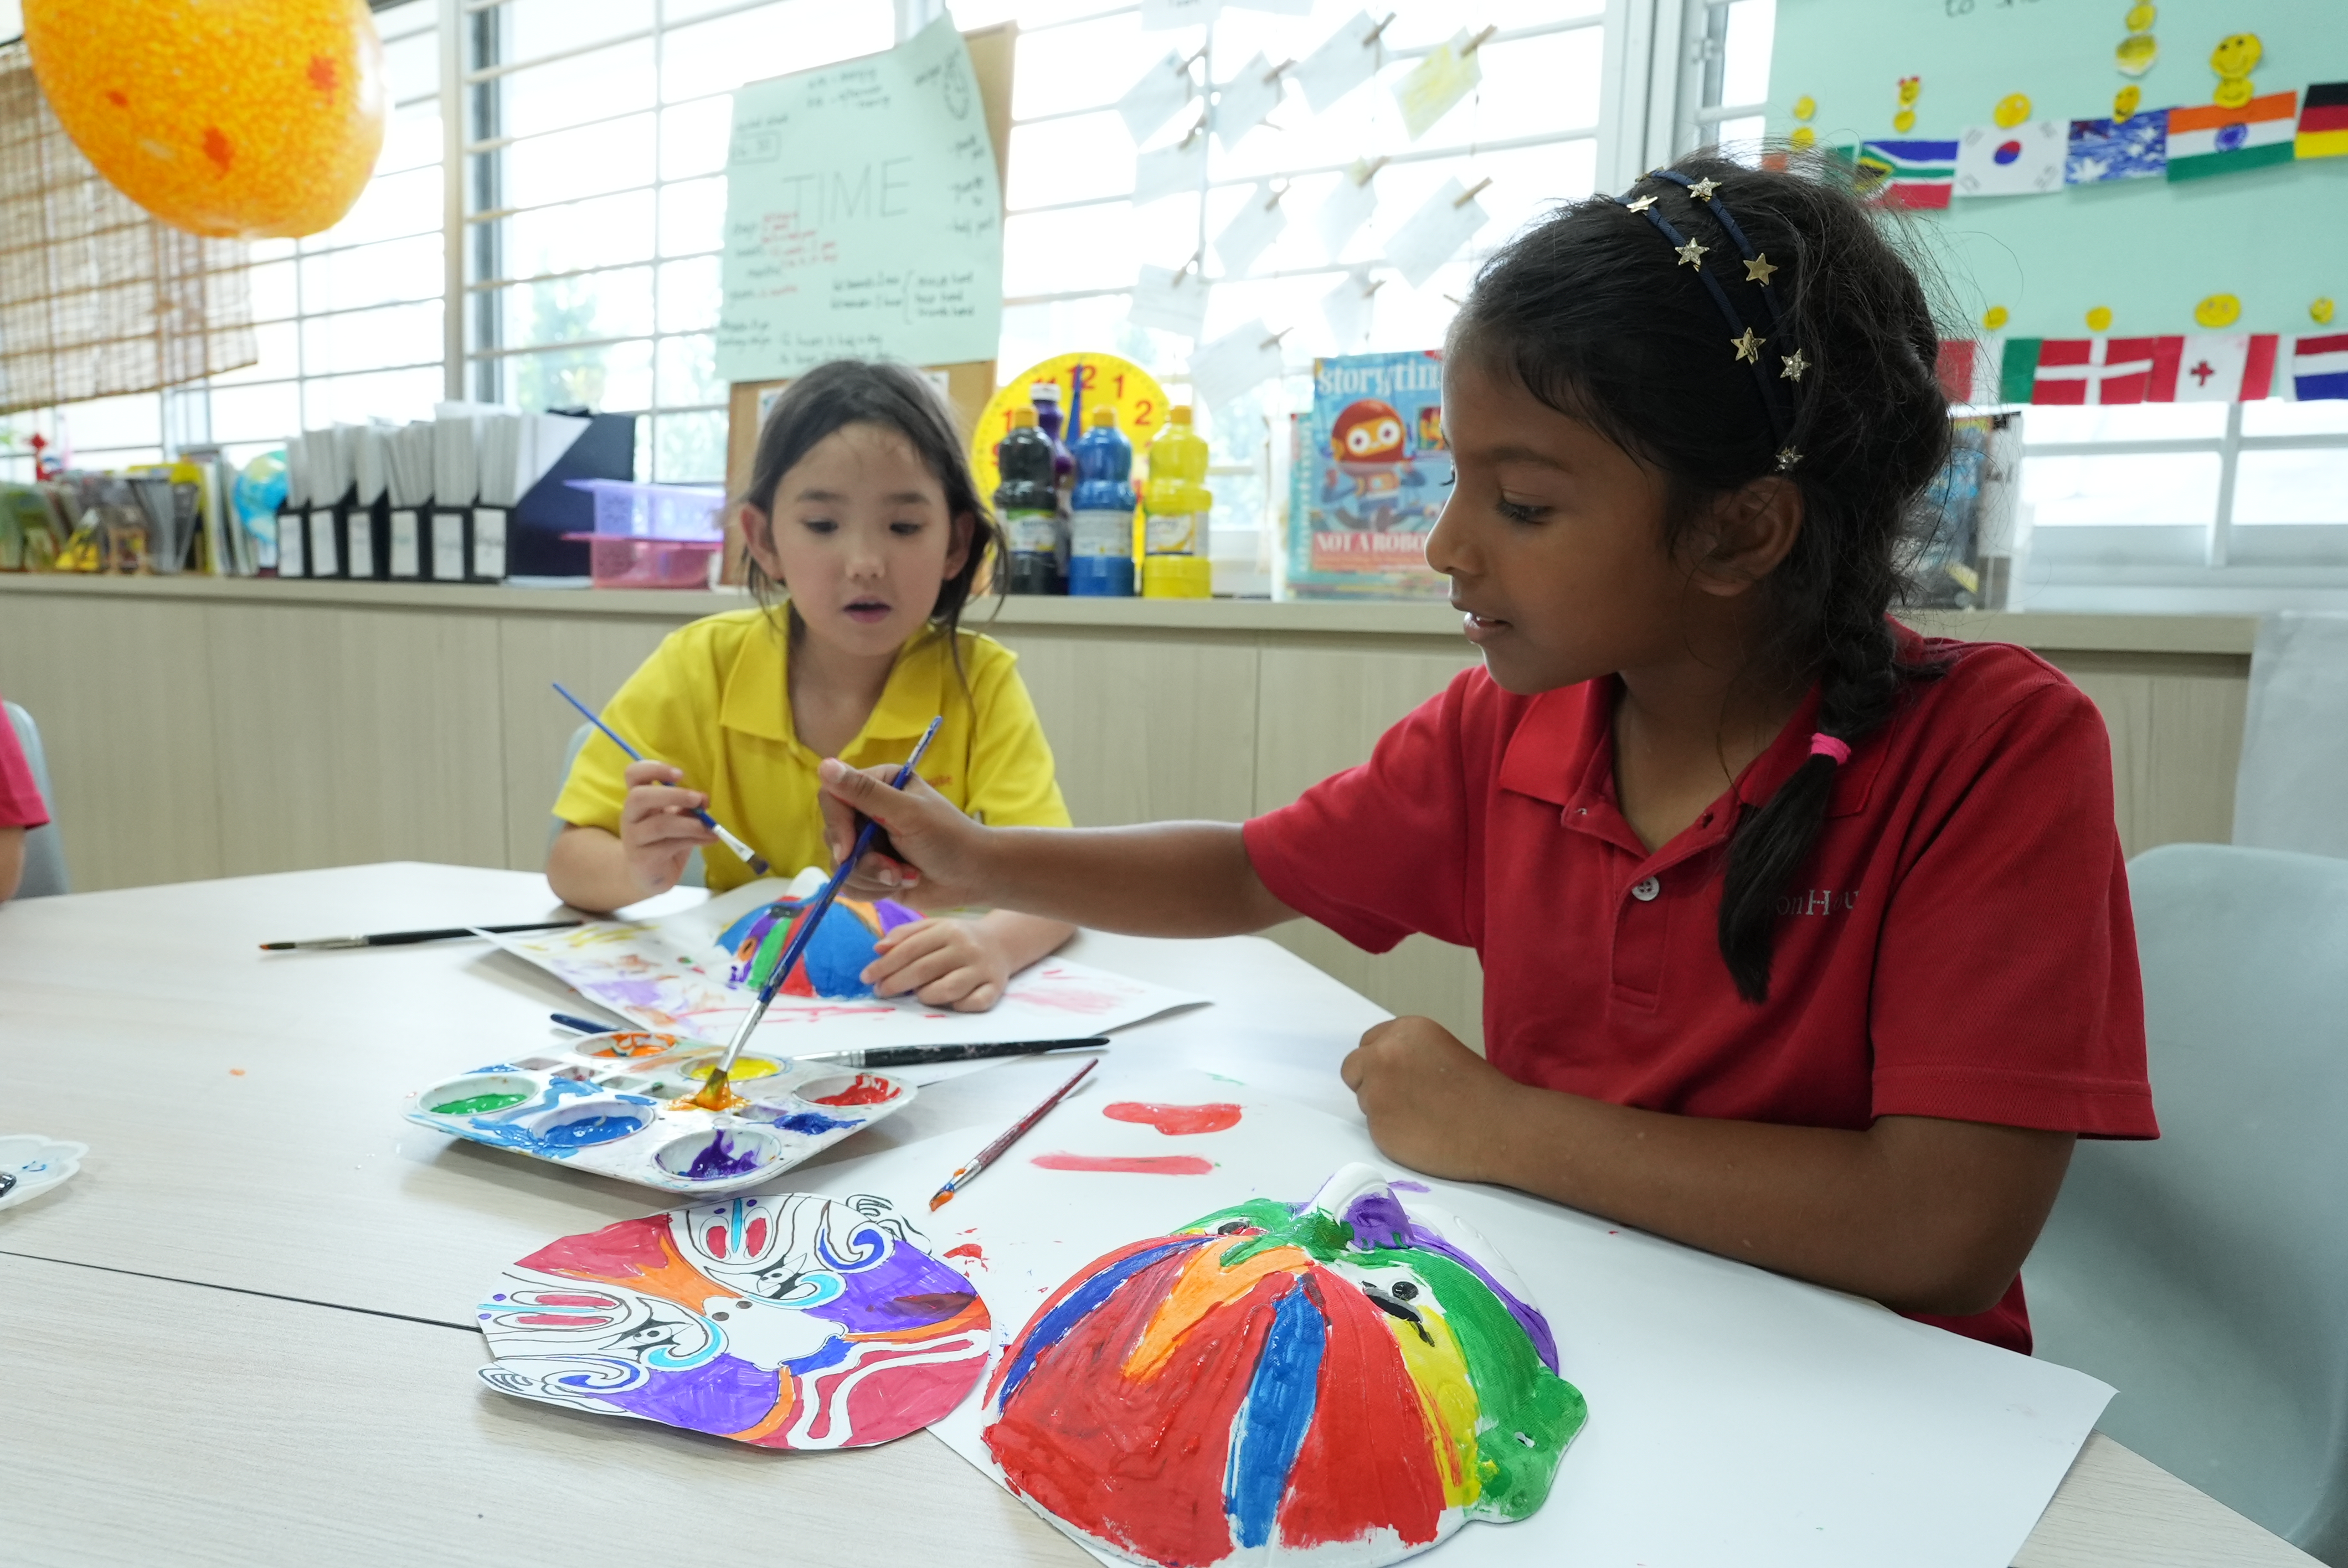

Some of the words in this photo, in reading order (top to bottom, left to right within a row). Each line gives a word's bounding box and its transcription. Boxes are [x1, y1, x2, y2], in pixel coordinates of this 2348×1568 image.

[782, 156, 913, 229] TIME
[1114, 374, 1124, 399] 1
[1318, 358, 1442, 398] storytim
[1135, 400, 1152, 425] 2
[1316, 532, 1351, 552] NOT
[1371, 532, 1426, 553] ROBO
